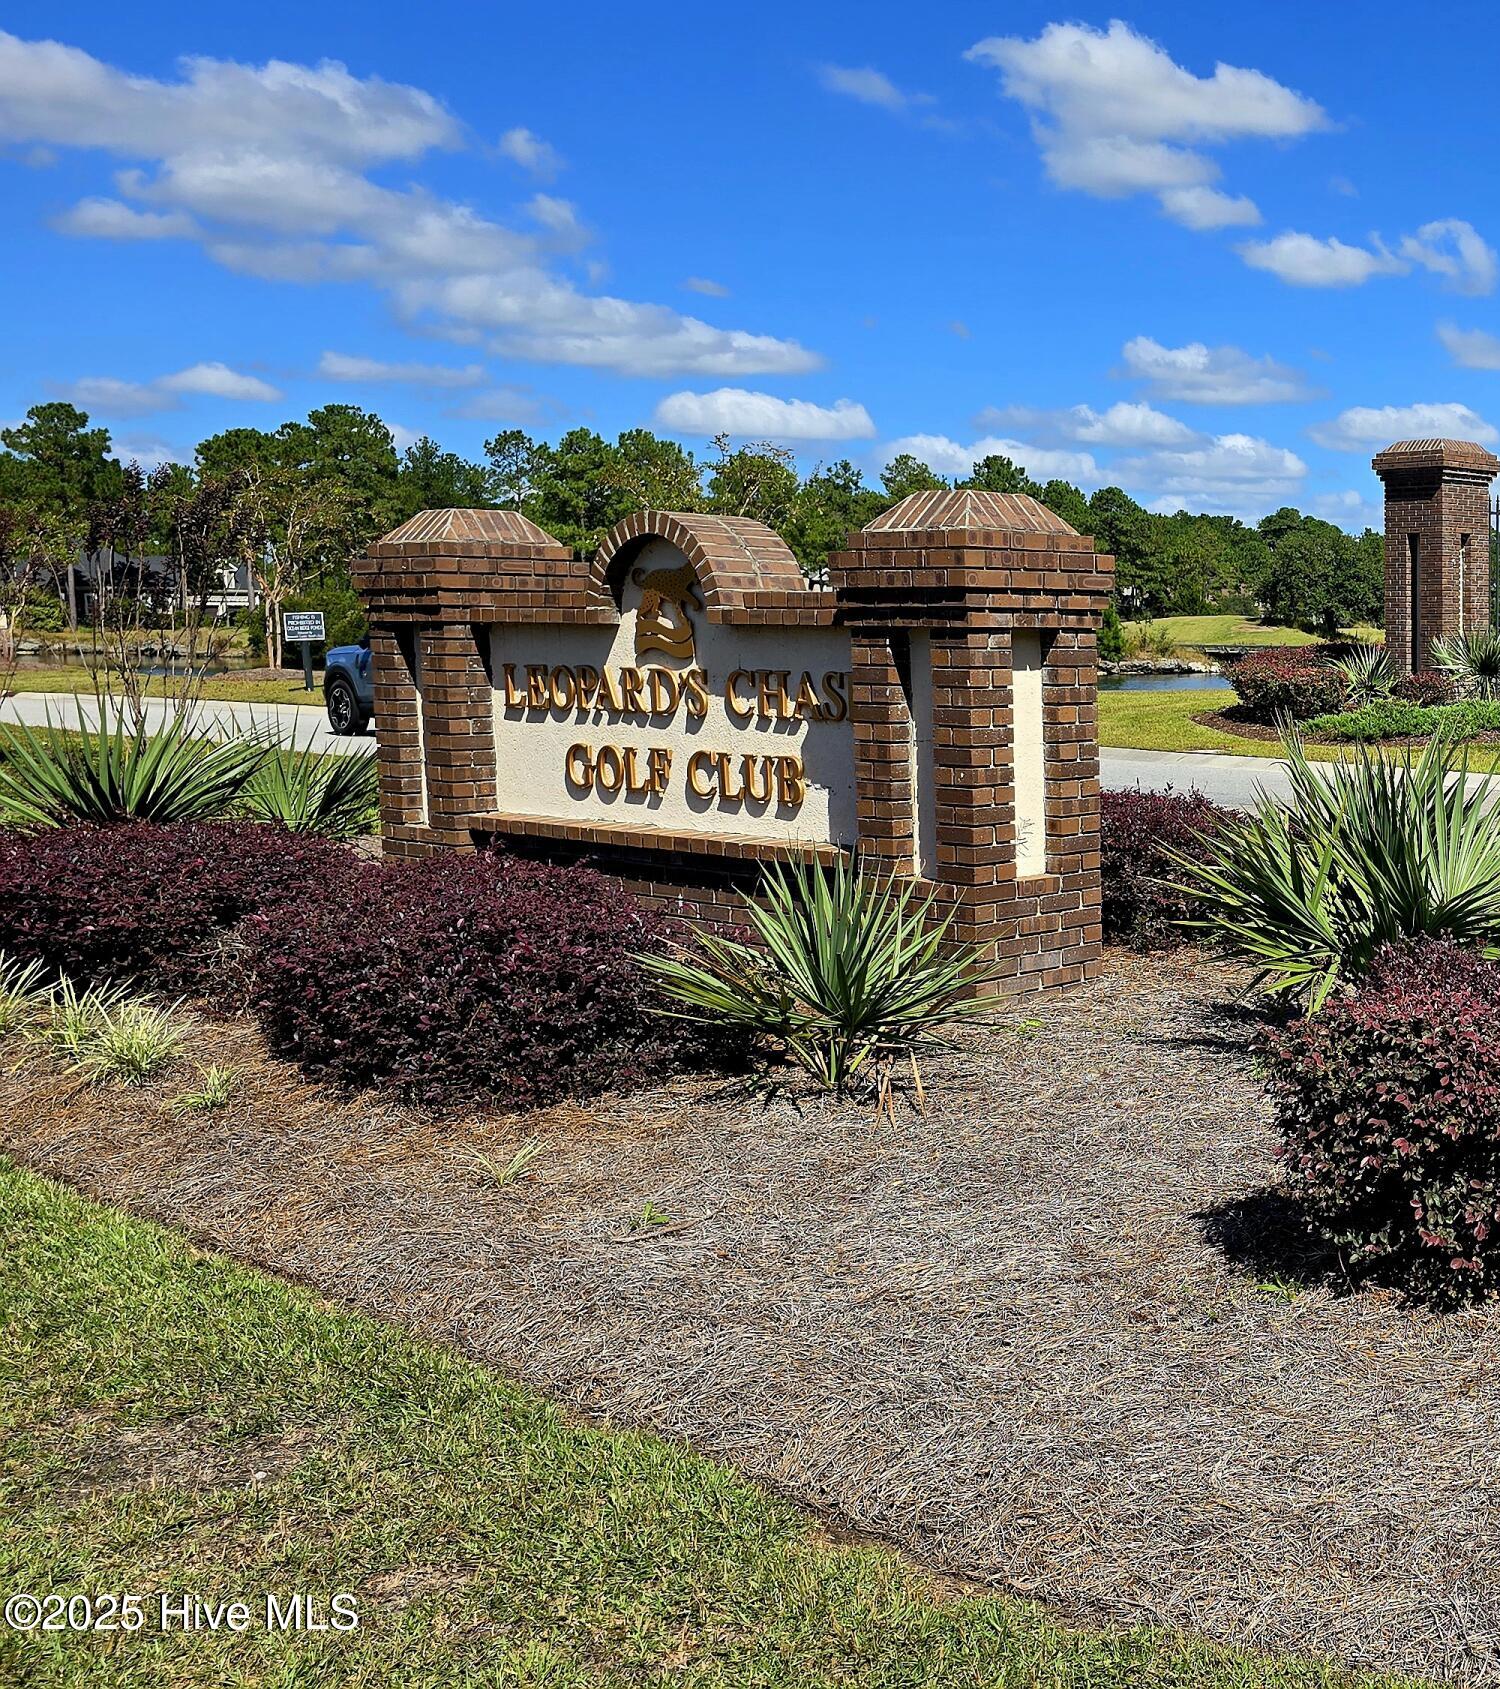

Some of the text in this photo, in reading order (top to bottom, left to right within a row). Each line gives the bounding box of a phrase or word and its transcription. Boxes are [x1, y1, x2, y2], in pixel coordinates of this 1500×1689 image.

[503, 662, 853, 722] LEOPARD'S CHAS
[566, 742, 806, 806] GOLF CLUB
